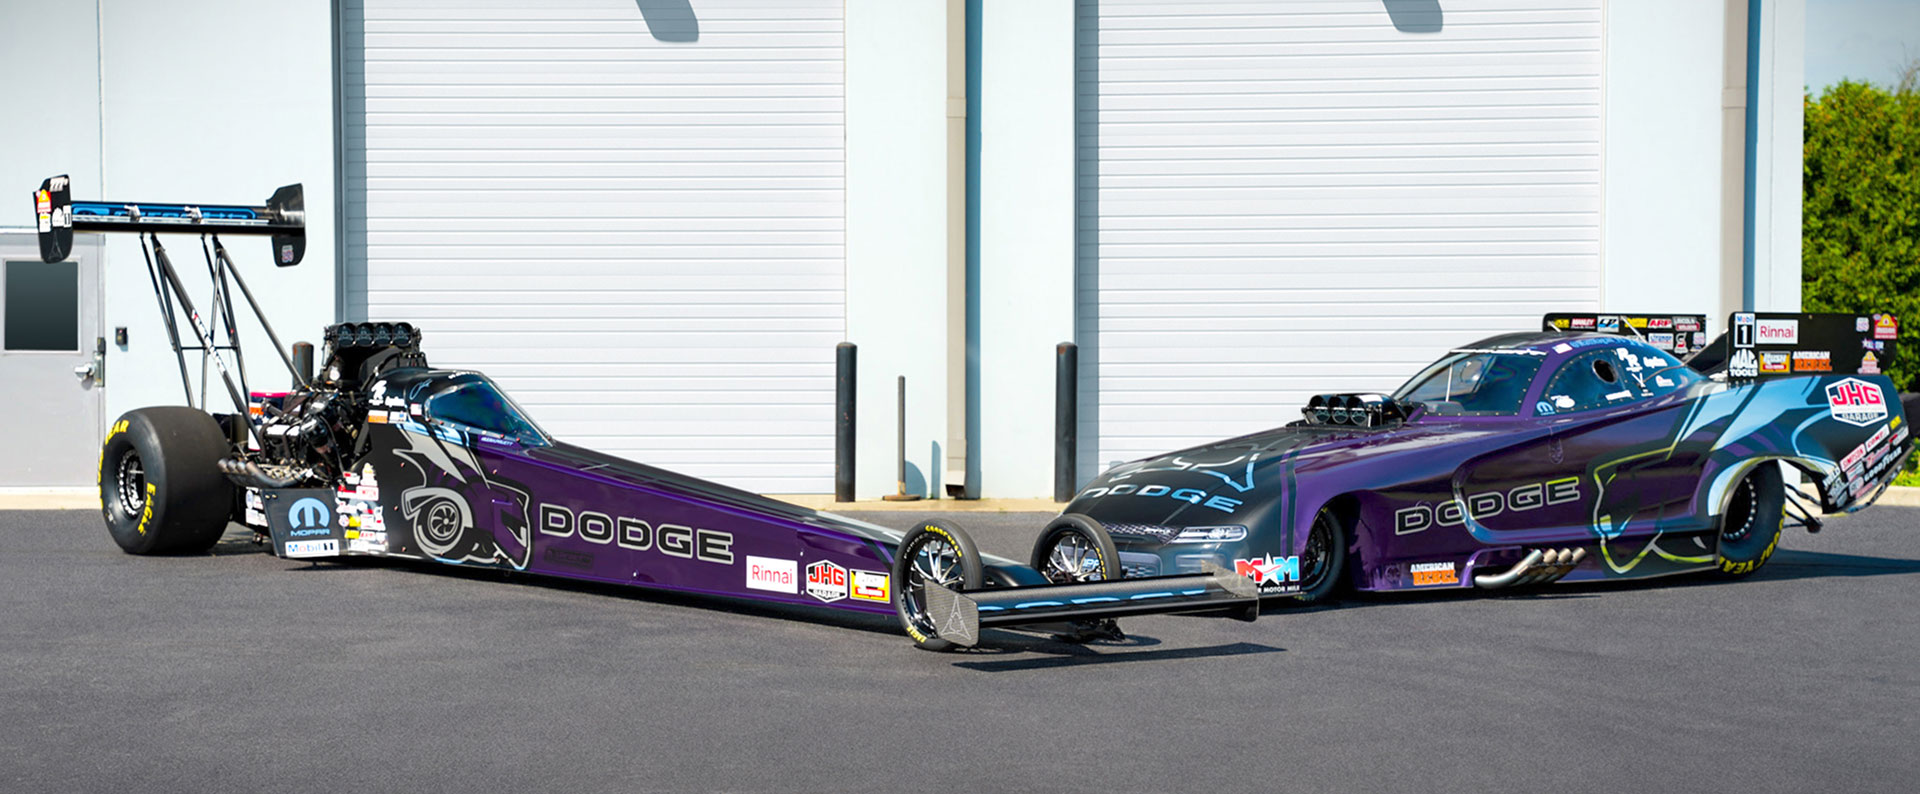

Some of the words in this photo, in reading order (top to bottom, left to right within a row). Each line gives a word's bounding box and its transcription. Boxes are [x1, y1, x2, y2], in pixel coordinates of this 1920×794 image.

[1650, 319, 1672, 328] ARP
[1760, 325, 1794, 338] Rinnai
[1740, 325, 1748, 344] 1
[1730, 349, 1758, 369] MAC
[1730, 369, 1758, 377] TOOLS
[1832, 384, 1881, 405] JHG
[1081, 484, 1243, 513] DODGE
[1395, 476, 1581, 535] DODGE
[290, 528, 331, 537] MOPAR
[539, 502, 735, 566] DODGE
[752, 564, 793, 585] Rinnai
[809, 565, 845, 586] JHG
[1410, 562, 1455, 574] AMERICAN
[1413, 569, 1459, 586] REBEL
[1264, 586, 1286, 594] MOTOR
